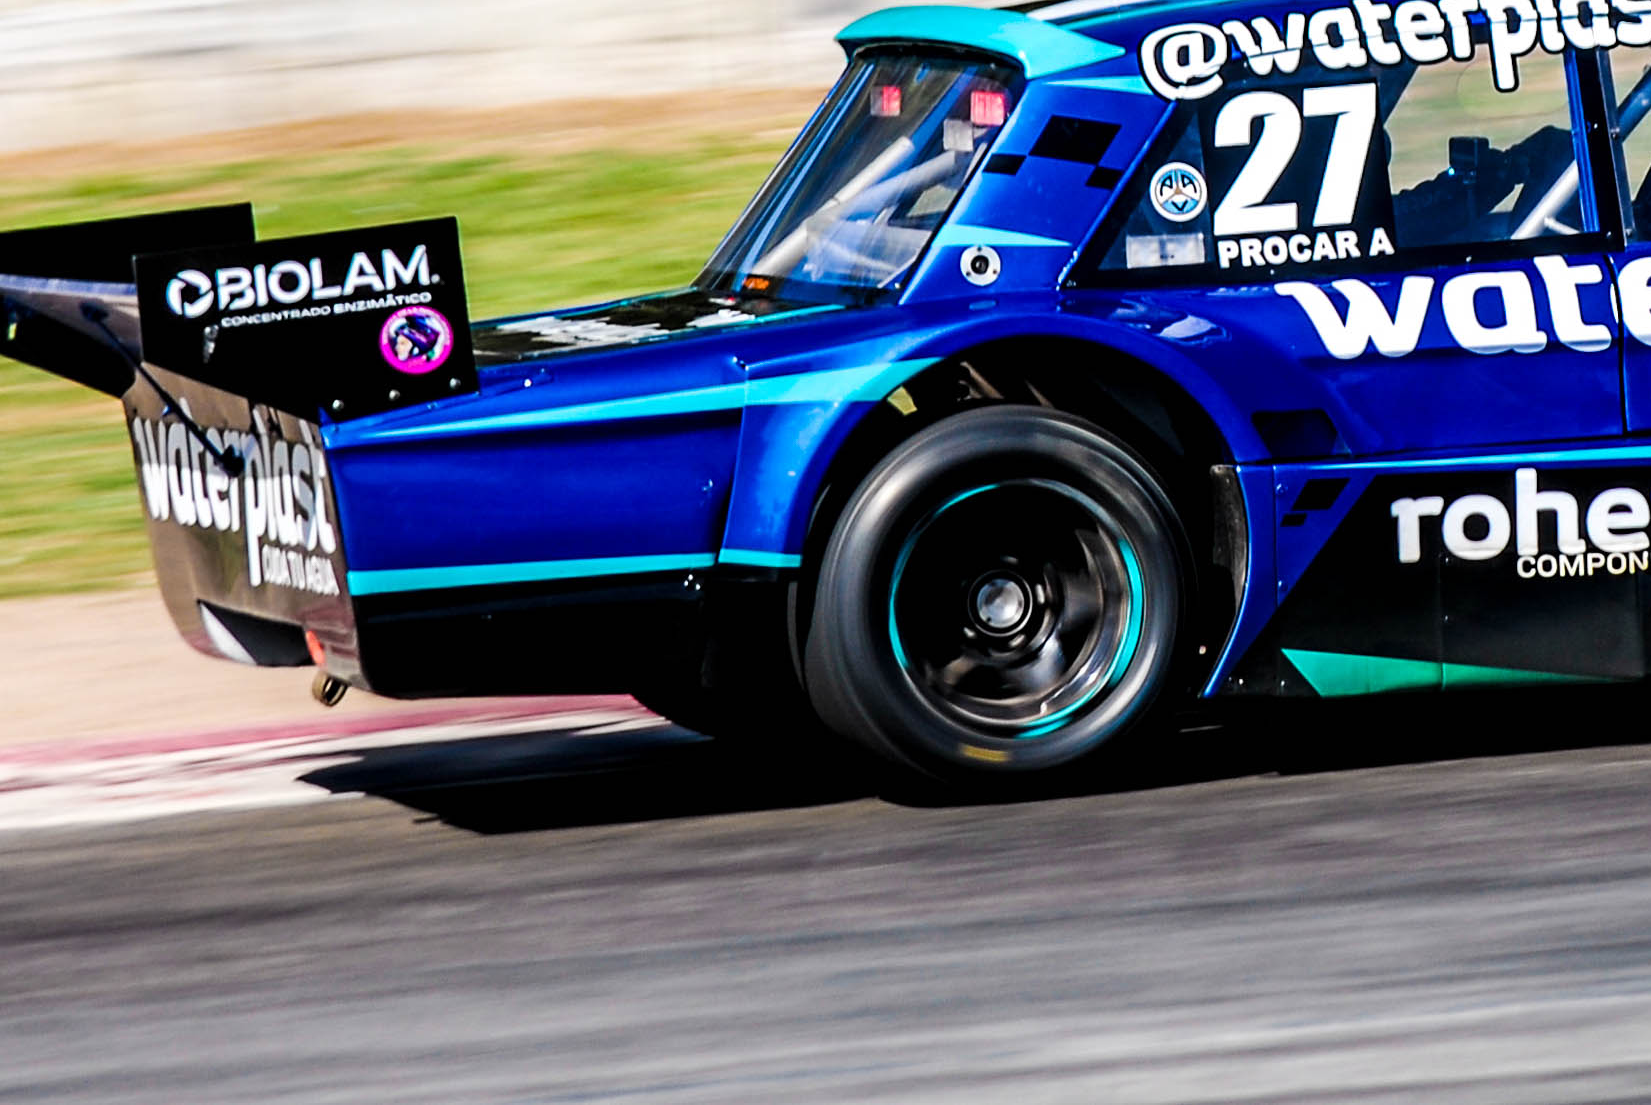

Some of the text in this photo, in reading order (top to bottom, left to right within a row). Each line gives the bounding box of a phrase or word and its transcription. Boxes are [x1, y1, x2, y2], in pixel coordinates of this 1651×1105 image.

[1212, 82, 1378, 237] 27
[1217, 227, 1395, 269] PROCAR A
[221, 306, 331, 328] CONCENTRADO
